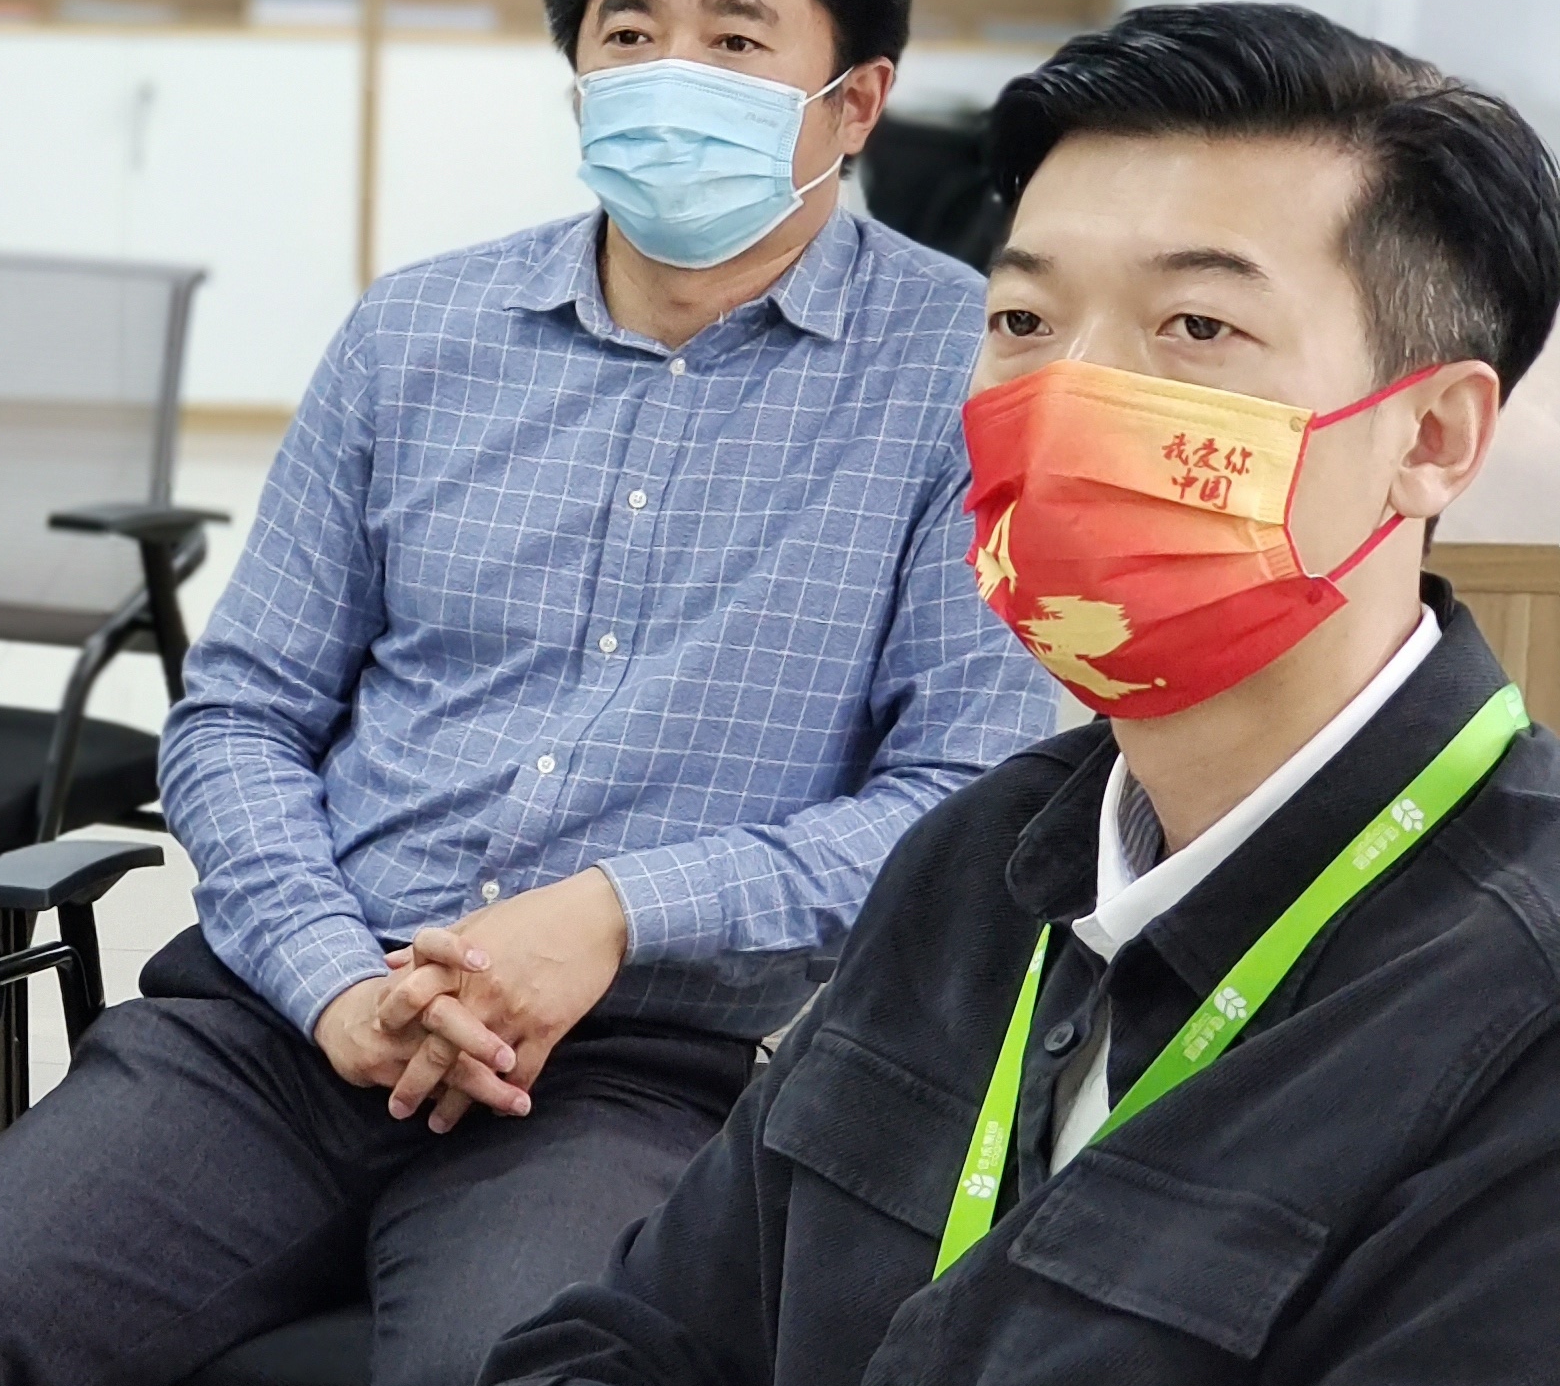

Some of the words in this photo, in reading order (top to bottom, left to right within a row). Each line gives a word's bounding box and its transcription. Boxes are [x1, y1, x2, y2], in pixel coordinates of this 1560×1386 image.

[1161, 432, 1253, 476] 我爱你
[1171, 467, 1233, 510] 中国
